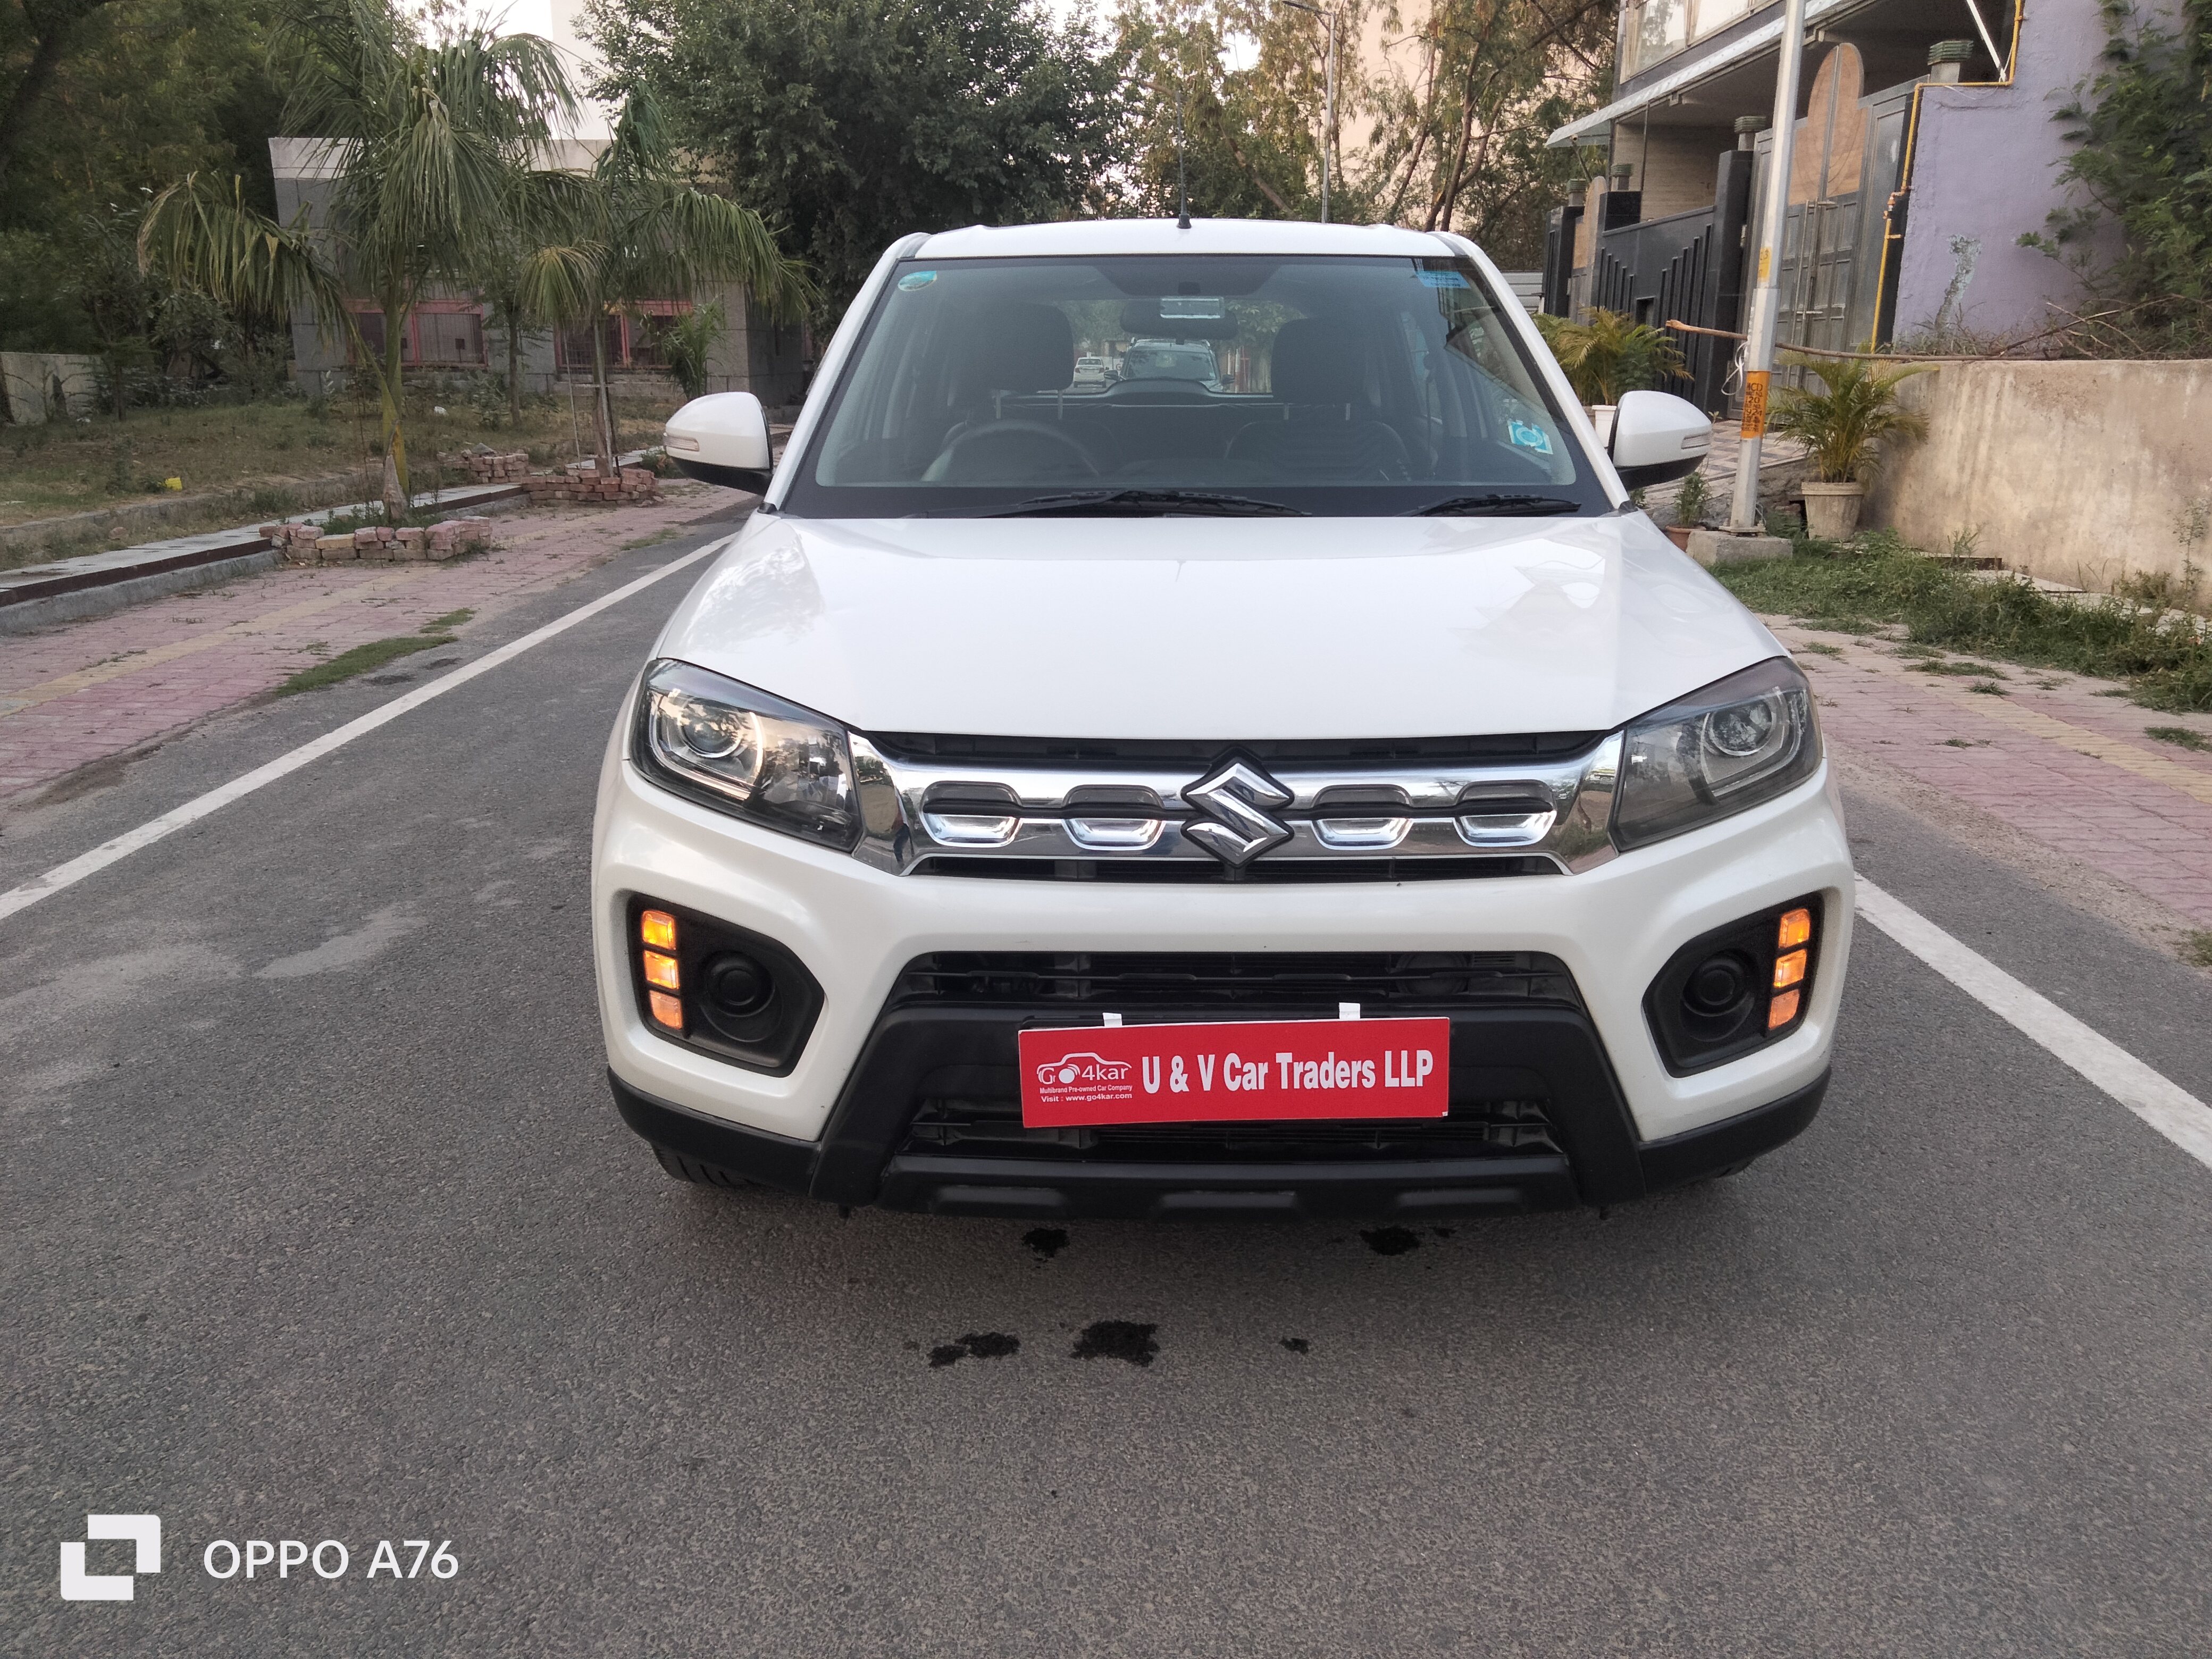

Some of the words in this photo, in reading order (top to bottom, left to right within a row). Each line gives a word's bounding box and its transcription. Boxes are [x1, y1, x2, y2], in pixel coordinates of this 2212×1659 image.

[1143, 1056, 1160, 1093] U
[1170, 1055, 1189, 1093] &
[1197, 1054, 1215, 1091] V
[1224, 1053, 1268, 1091] Car
[1276, 1052, 1376, 1089] Traders
[1385, 1050, 1433, 1087] LLP
